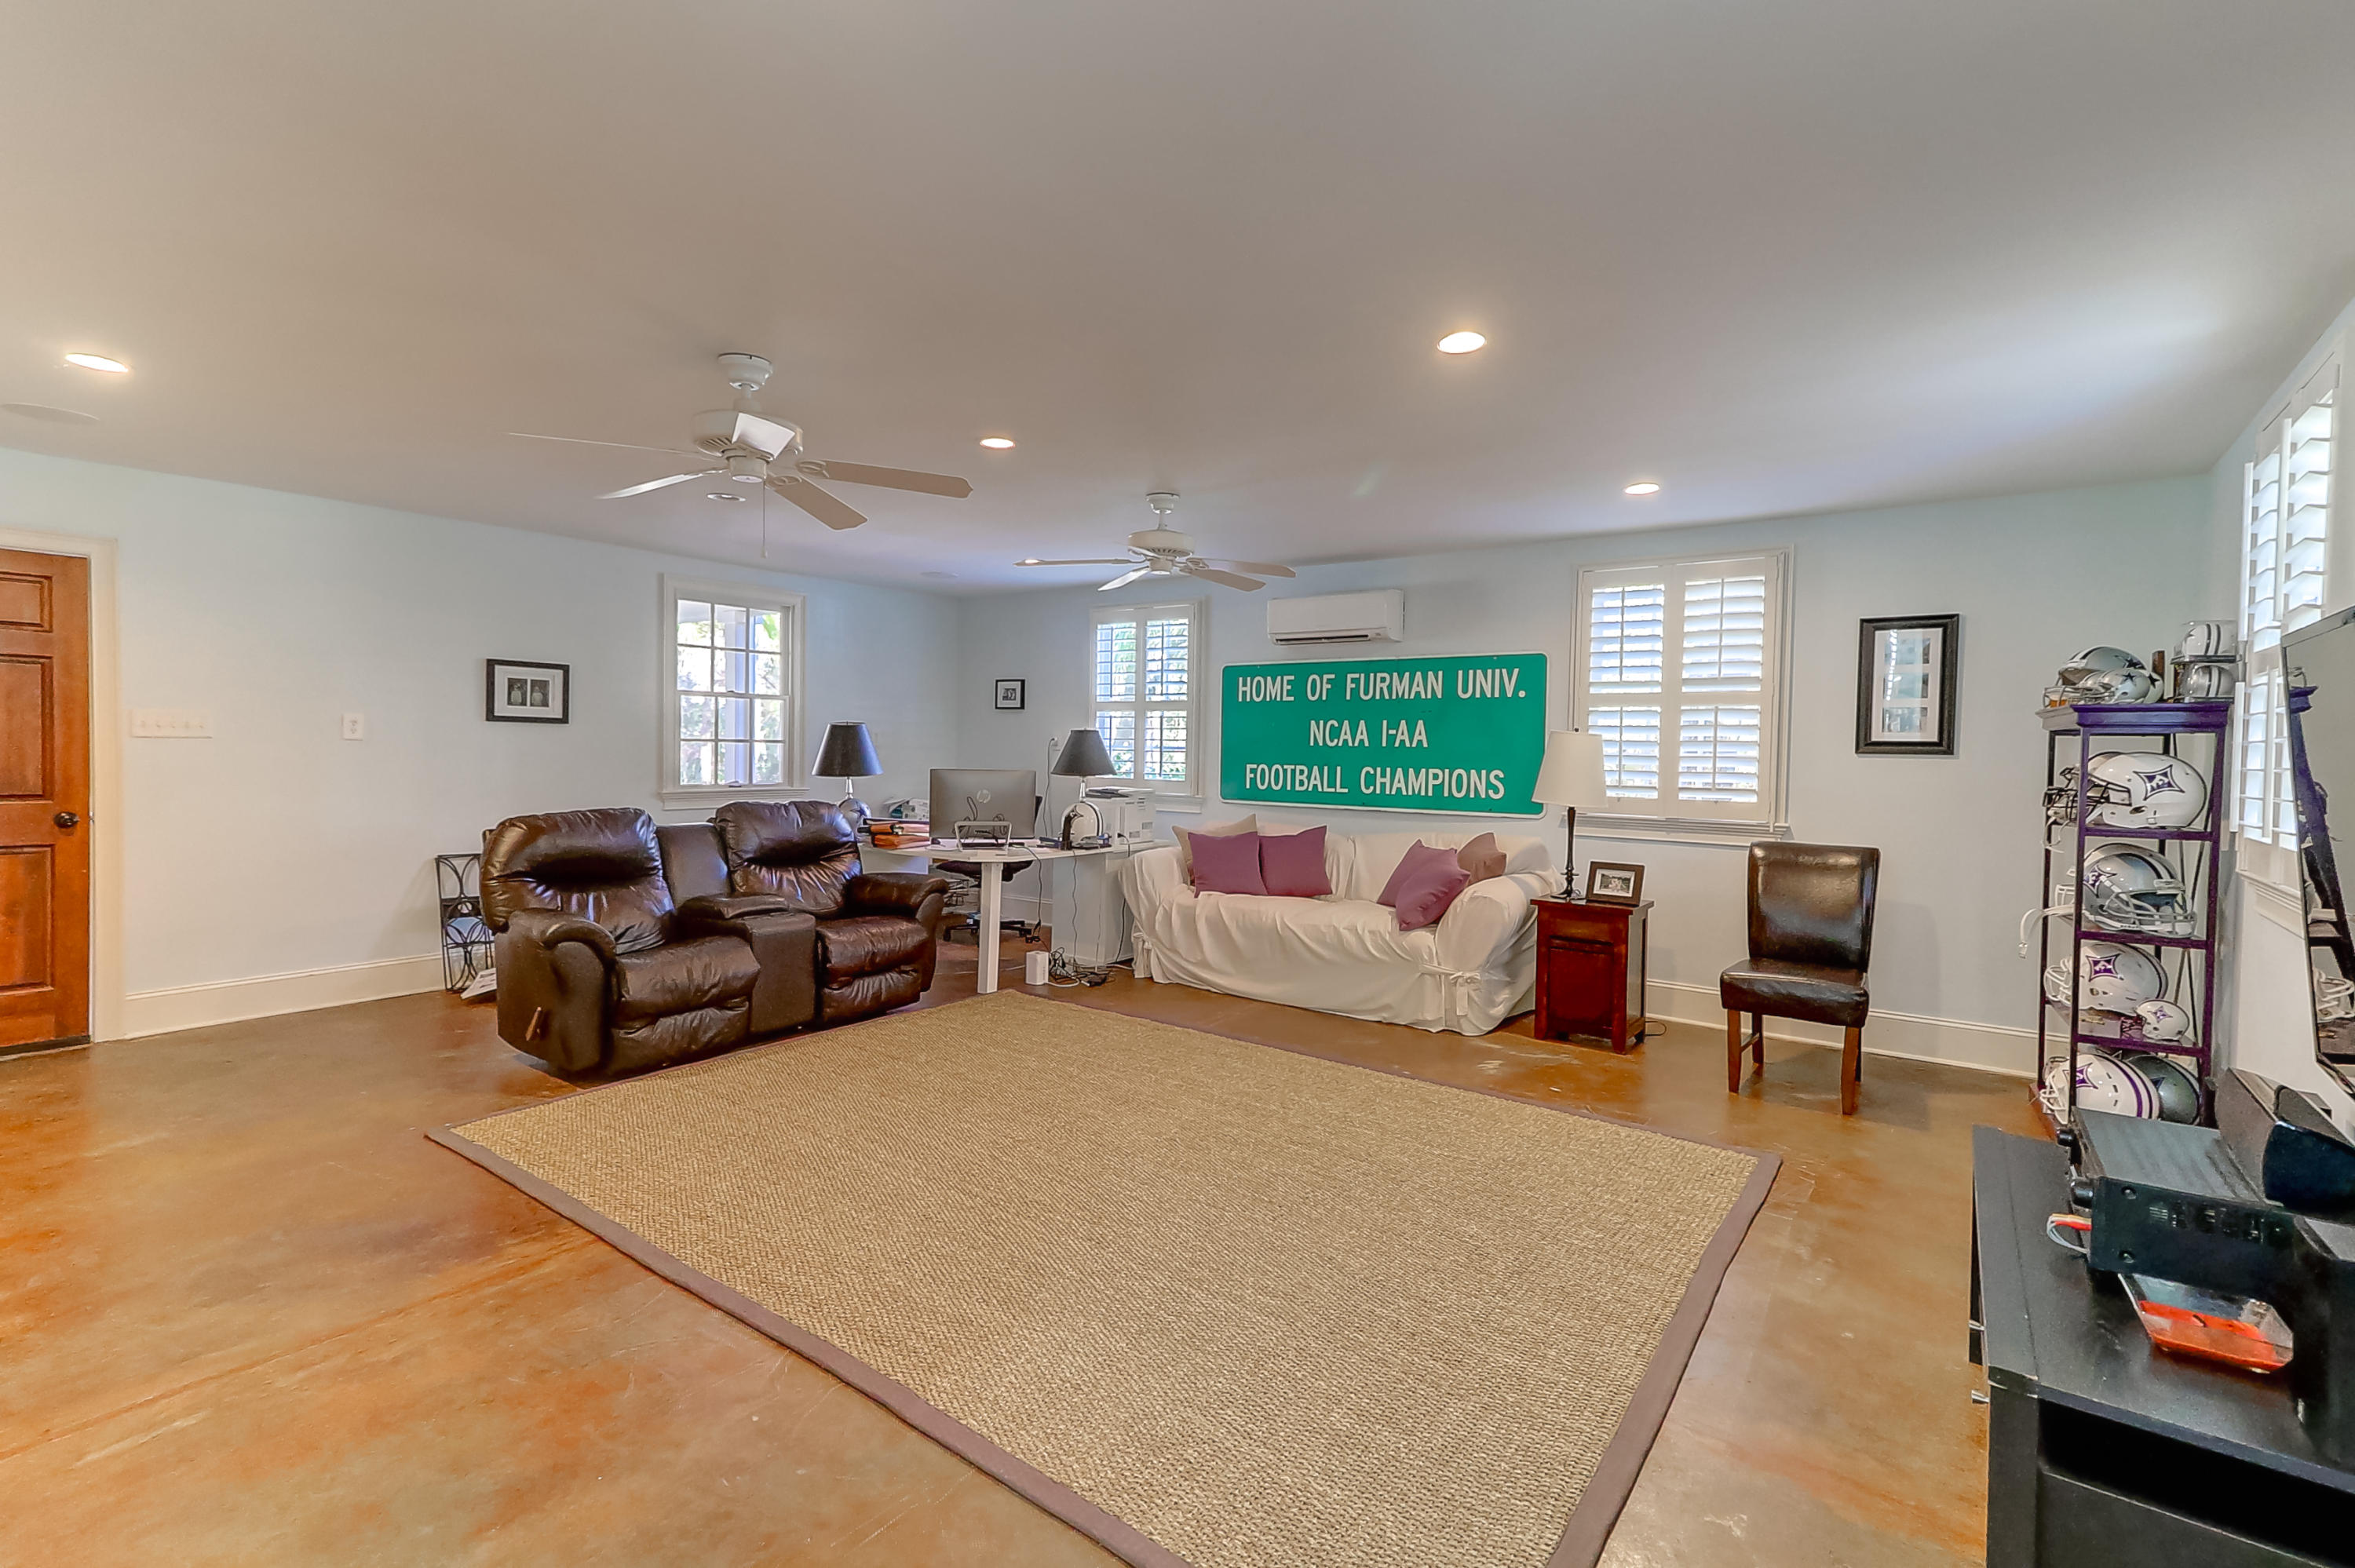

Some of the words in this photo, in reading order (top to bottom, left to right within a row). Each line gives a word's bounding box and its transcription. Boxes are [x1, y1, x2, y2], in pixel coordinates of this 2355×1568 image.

[1238, 675, 1295, 702] HOME
[1306, 673, 1335, 701] OF
[1345, 670, 1444, 701] FURMAN
[1457, 667, 1527, 699] UNIV.
[1309, 719, 1369, 747] NCAA
[1382, 719, 1429, 748] I-AA
[1245, 764, 1349, 793] FOOTBALL
[1360, 766, 1506, 800] CHAMPIONS
